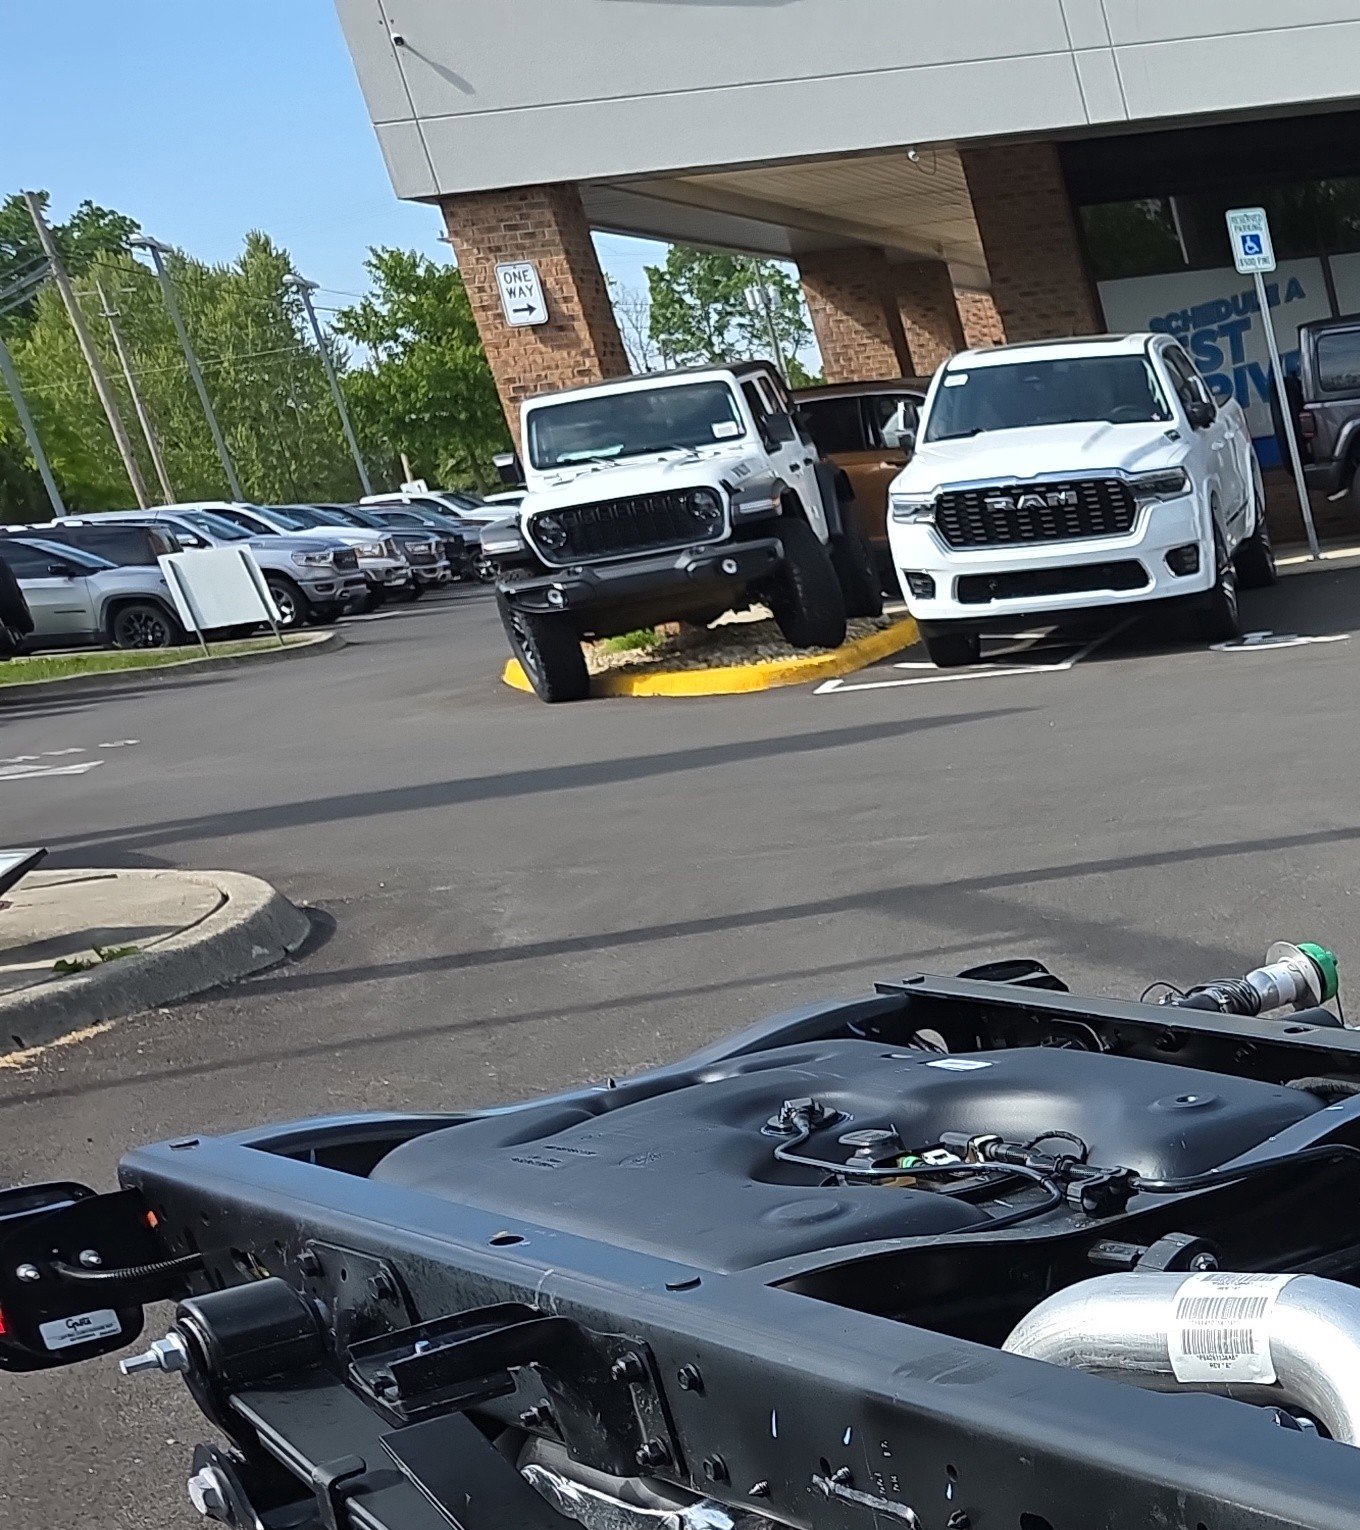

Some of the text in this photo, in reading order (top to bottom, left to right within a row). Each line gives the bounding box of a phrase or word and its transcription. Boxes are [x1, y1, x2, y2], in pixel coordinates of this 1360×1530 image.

[503, 269, 532, 285] ONE
[506, 284, 534, 299] WAY
[1284, 277, 1306, 303] A
[1177, 316, 1251, 374] ST
[983, 491, 1079, 512] RAM
